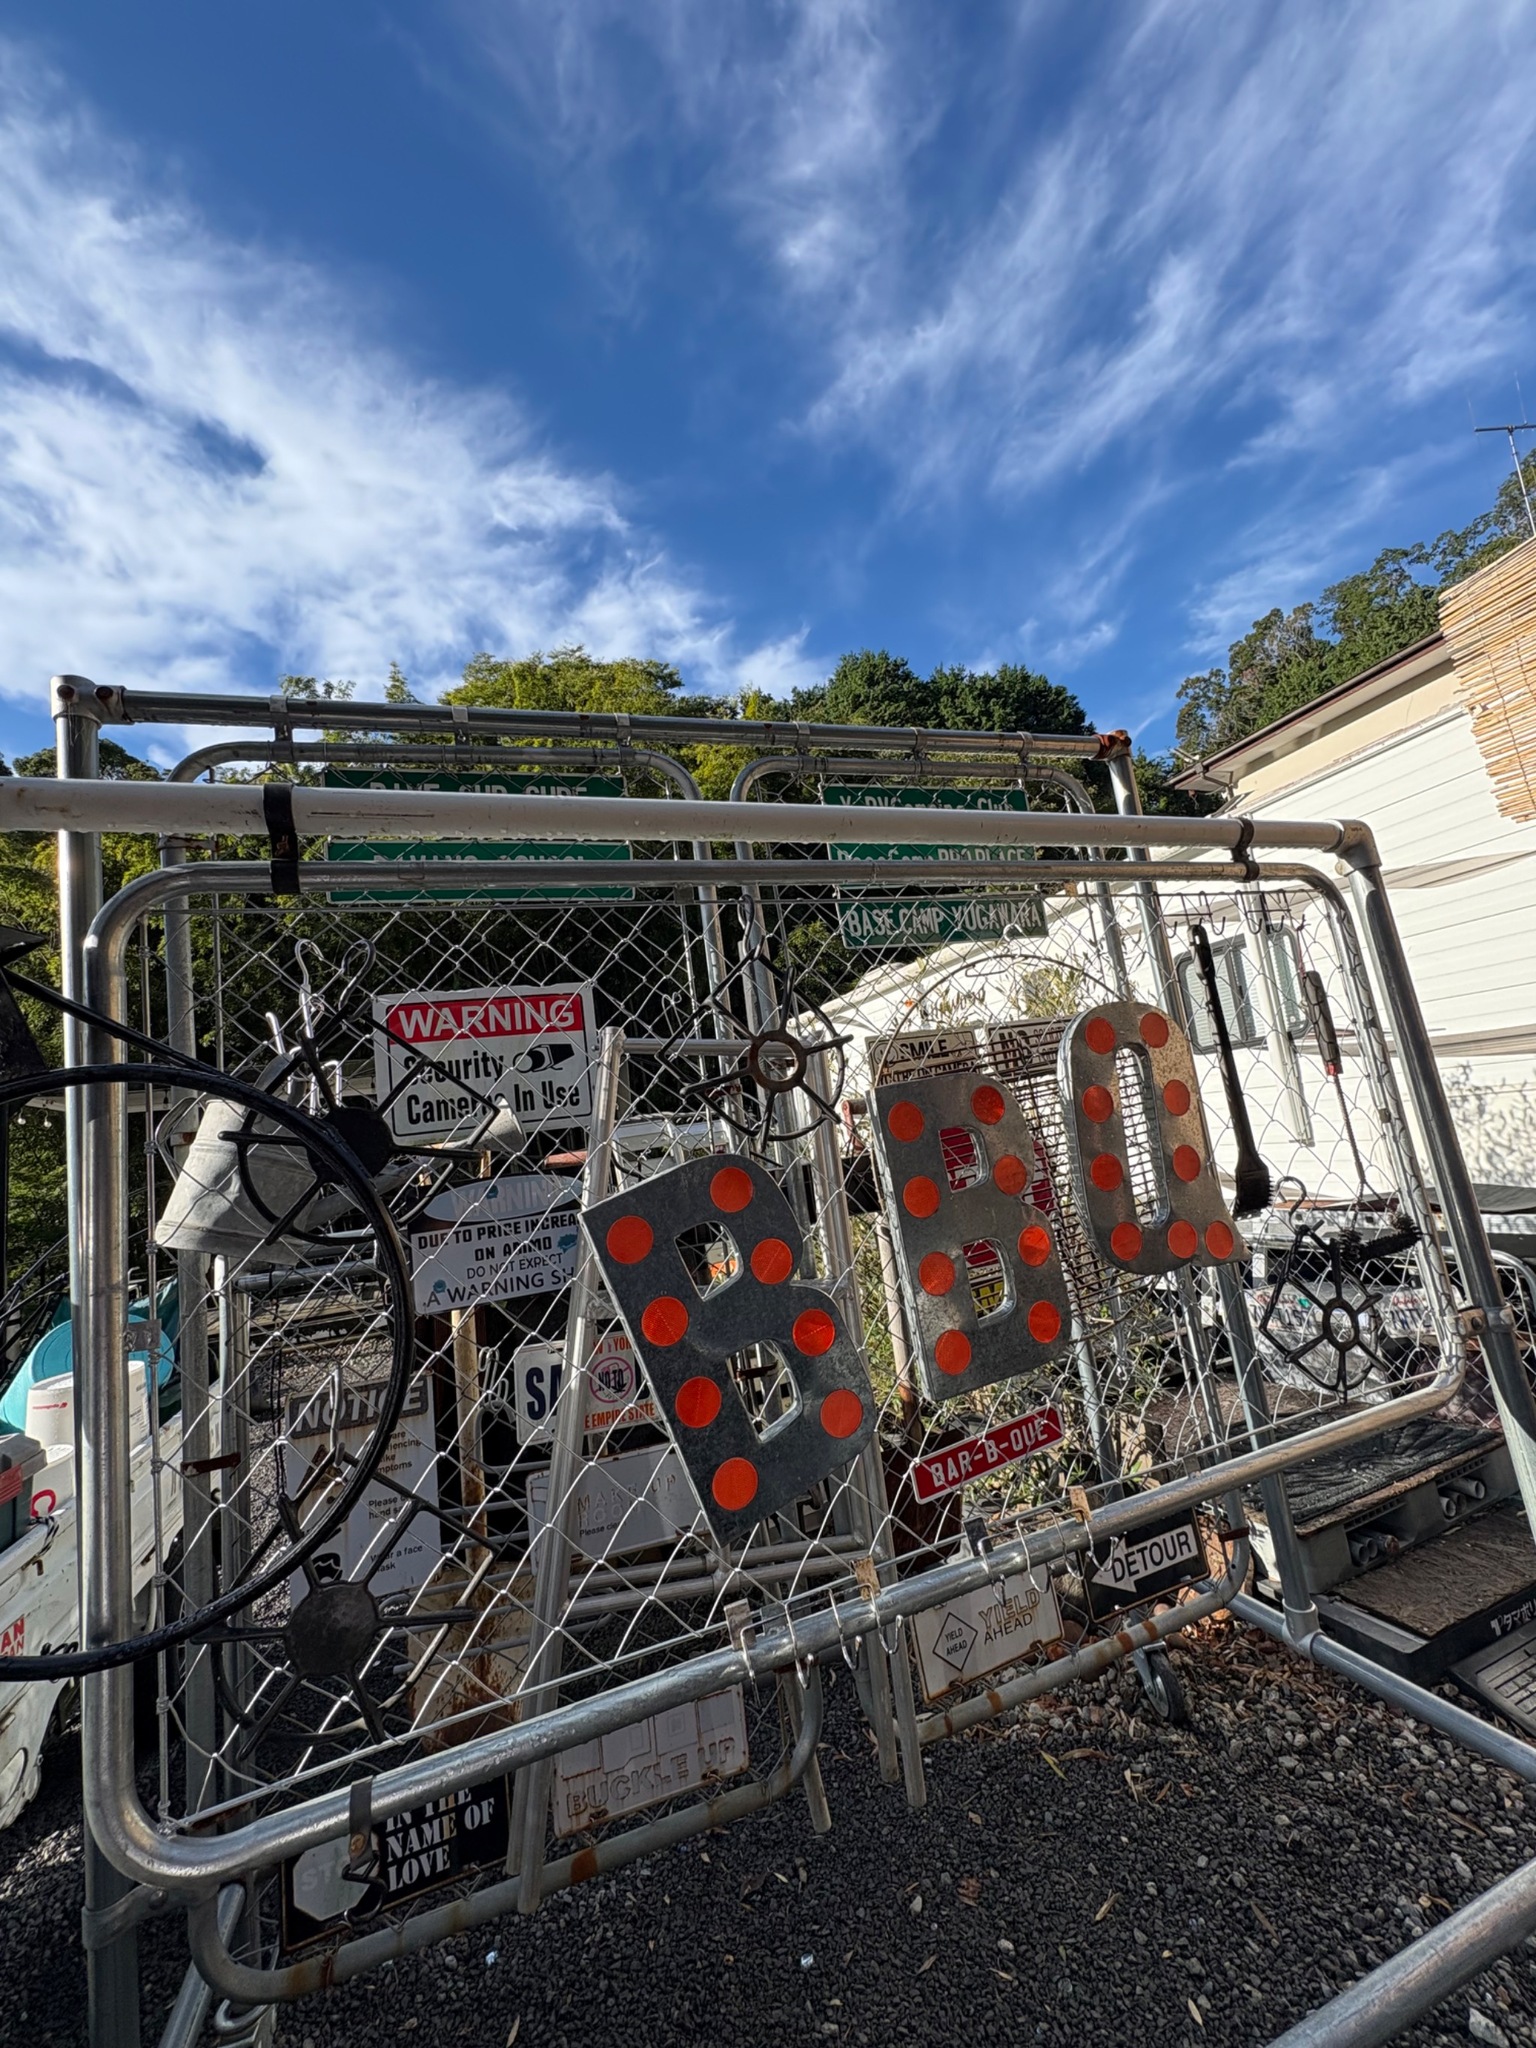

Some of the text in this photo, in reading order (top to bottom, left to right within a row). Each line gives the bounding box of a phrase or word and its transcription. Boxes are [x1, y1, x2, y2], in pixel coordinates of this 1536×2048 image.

[849, 898, 1043, 938] BASE CAMP YUGAWARA
[398, 999, 575, 1039] WARNING
[899, 1038, 950, 1060] SMILE
[513, 1083, 535, 1113] In
[541, 1080, 580, 1109] Use
[450, 1176, 560, 1220] WARNIN
[418, 1233, 448, 1250] DUE
[454, 1228, 472, 1244] TO
[477, 1224, 522, 1240] PRICE
[474, 1236, 552, 1262] ON AMMO
[467, 1253, 563, 1280] DO NOT EXPECT
[447, 1272, 544, 1303] WARNING
[591, 1407, 628, 1428] EMPIRE
[628, 1403, 656, 1422] STATE
[930, 1416, 1048, 1488] BAR-B-QUE
[368, 1495, 398, 1508] Please
[368, 1506, 391, 1520] hand
[579, 1525, 604, 1538] Please
[403, 1545, 423, 1556] face
[1112, 1530, 1192, 1584] DETOUR
[978, 1587, 1041, 1630] YIELD
[944, 1627, 963, 1643] YIELD
[983, 1612, 1034, 1645] AHEAD
[946, 1640, 968, 1657] AHEAD
[566, 1736, 737, 1818] BUCKLE UP
[385, 1797, 495, 1864] NAME OF
[388, 1844, 451, 1893] LOVE
